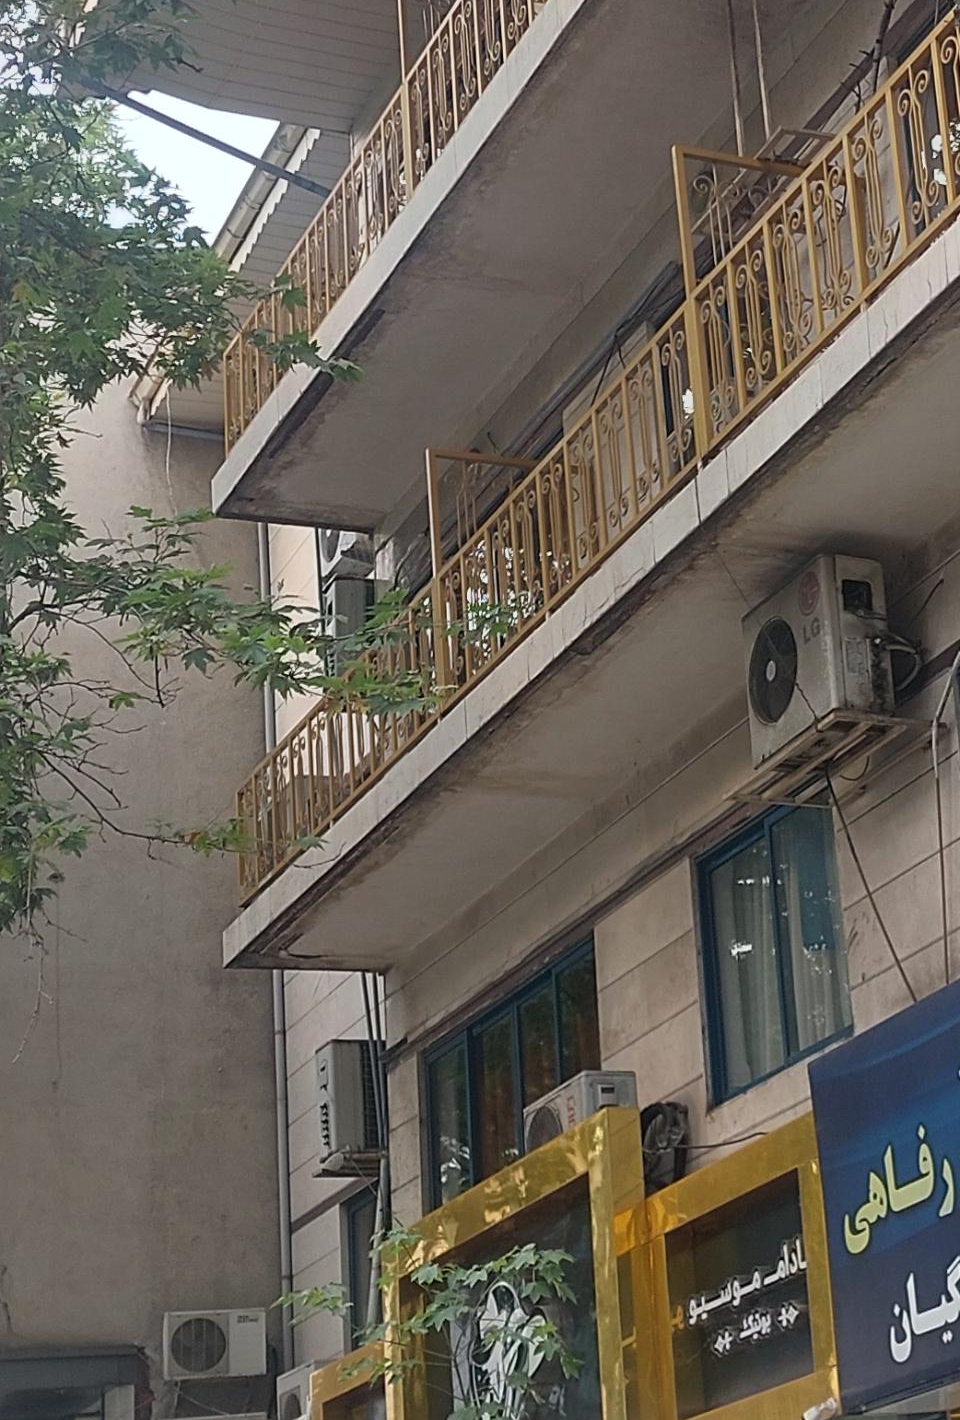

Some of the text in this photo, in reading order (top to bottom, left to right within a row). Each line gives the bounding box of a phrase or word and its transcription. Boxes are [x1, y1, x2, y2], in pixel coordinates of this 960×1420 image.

[803, 617, 821, 645] LG
[844, 1125, 955, 1254] رفاهی
[688, 1237, 808, 1326] ادام موسیو
[739, 1309, 772, 1340] بوتیک
